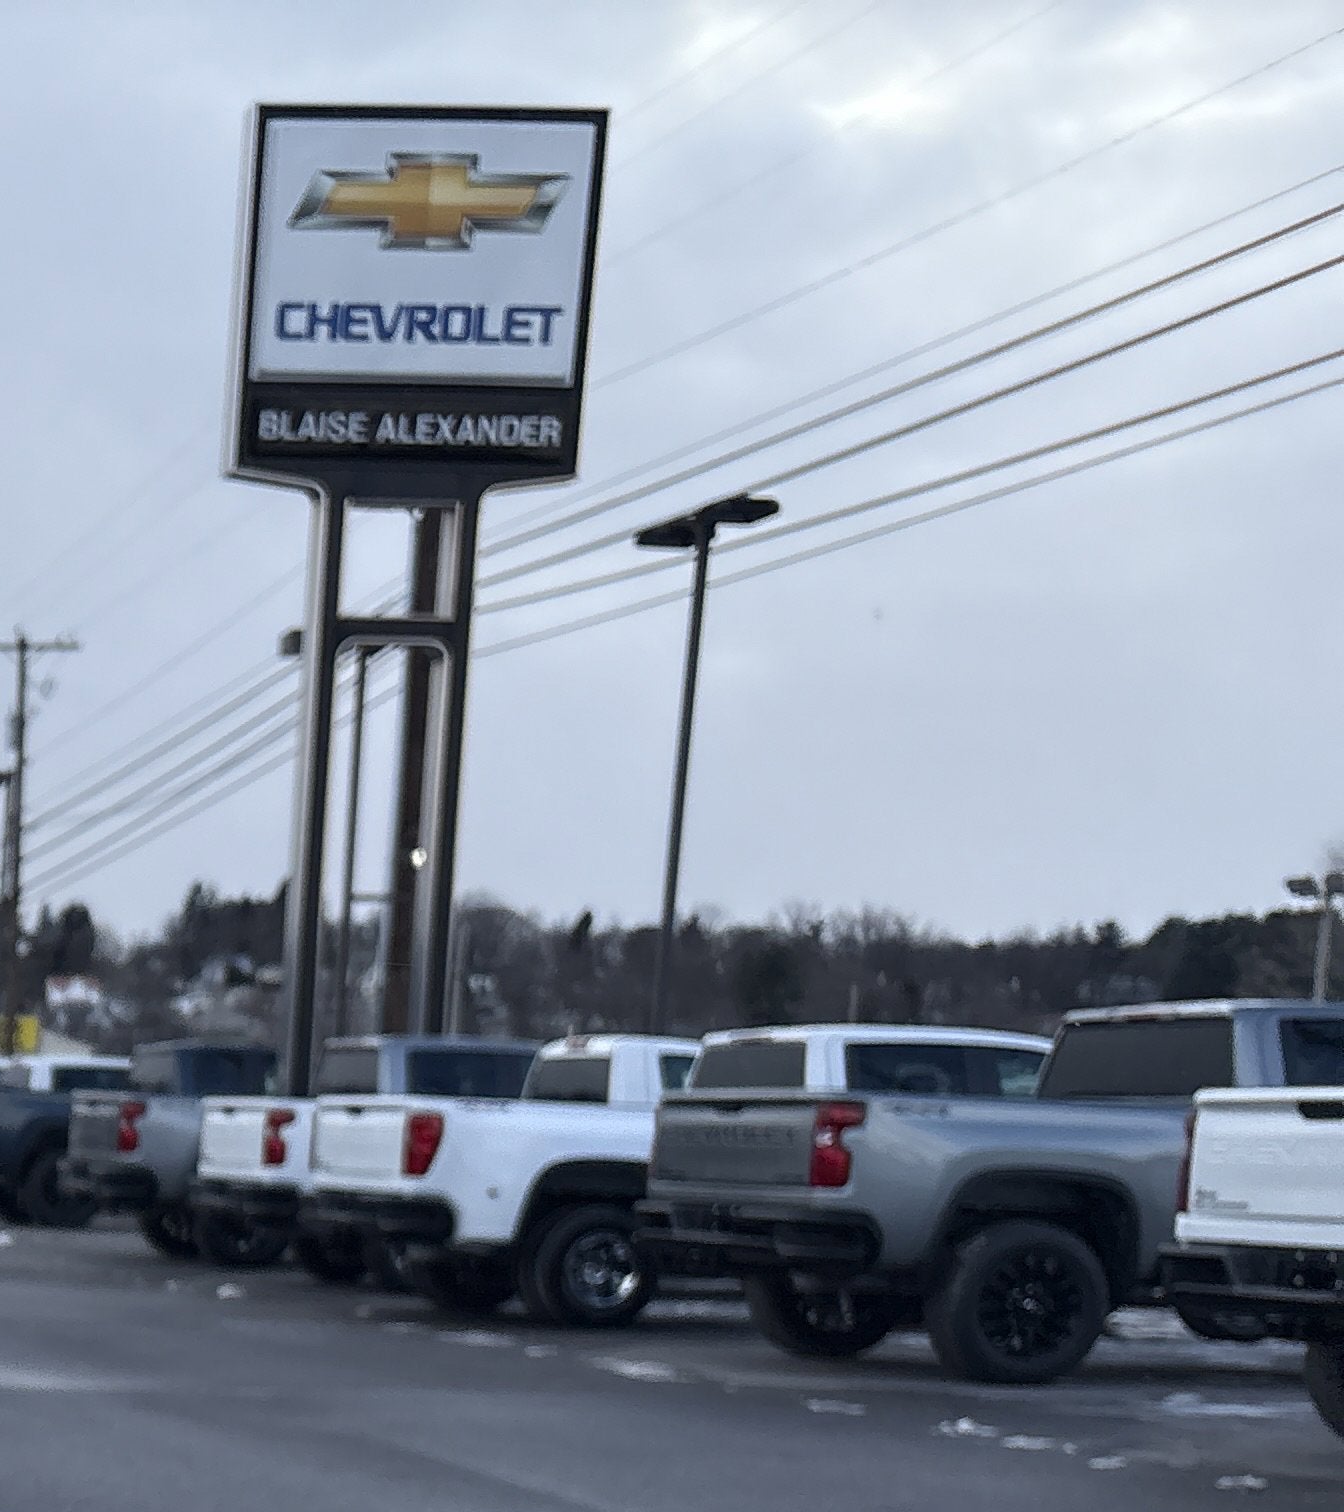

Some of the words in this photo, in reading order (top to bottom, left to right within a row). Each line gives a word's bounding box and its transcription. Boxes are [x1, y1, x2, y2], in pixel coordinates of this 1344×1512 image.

[275, 302, 562, 344] CHEVROLET
[258, 410, 369, 442] BLAISE
[377, 413, 561, 447] ALEXANDER
